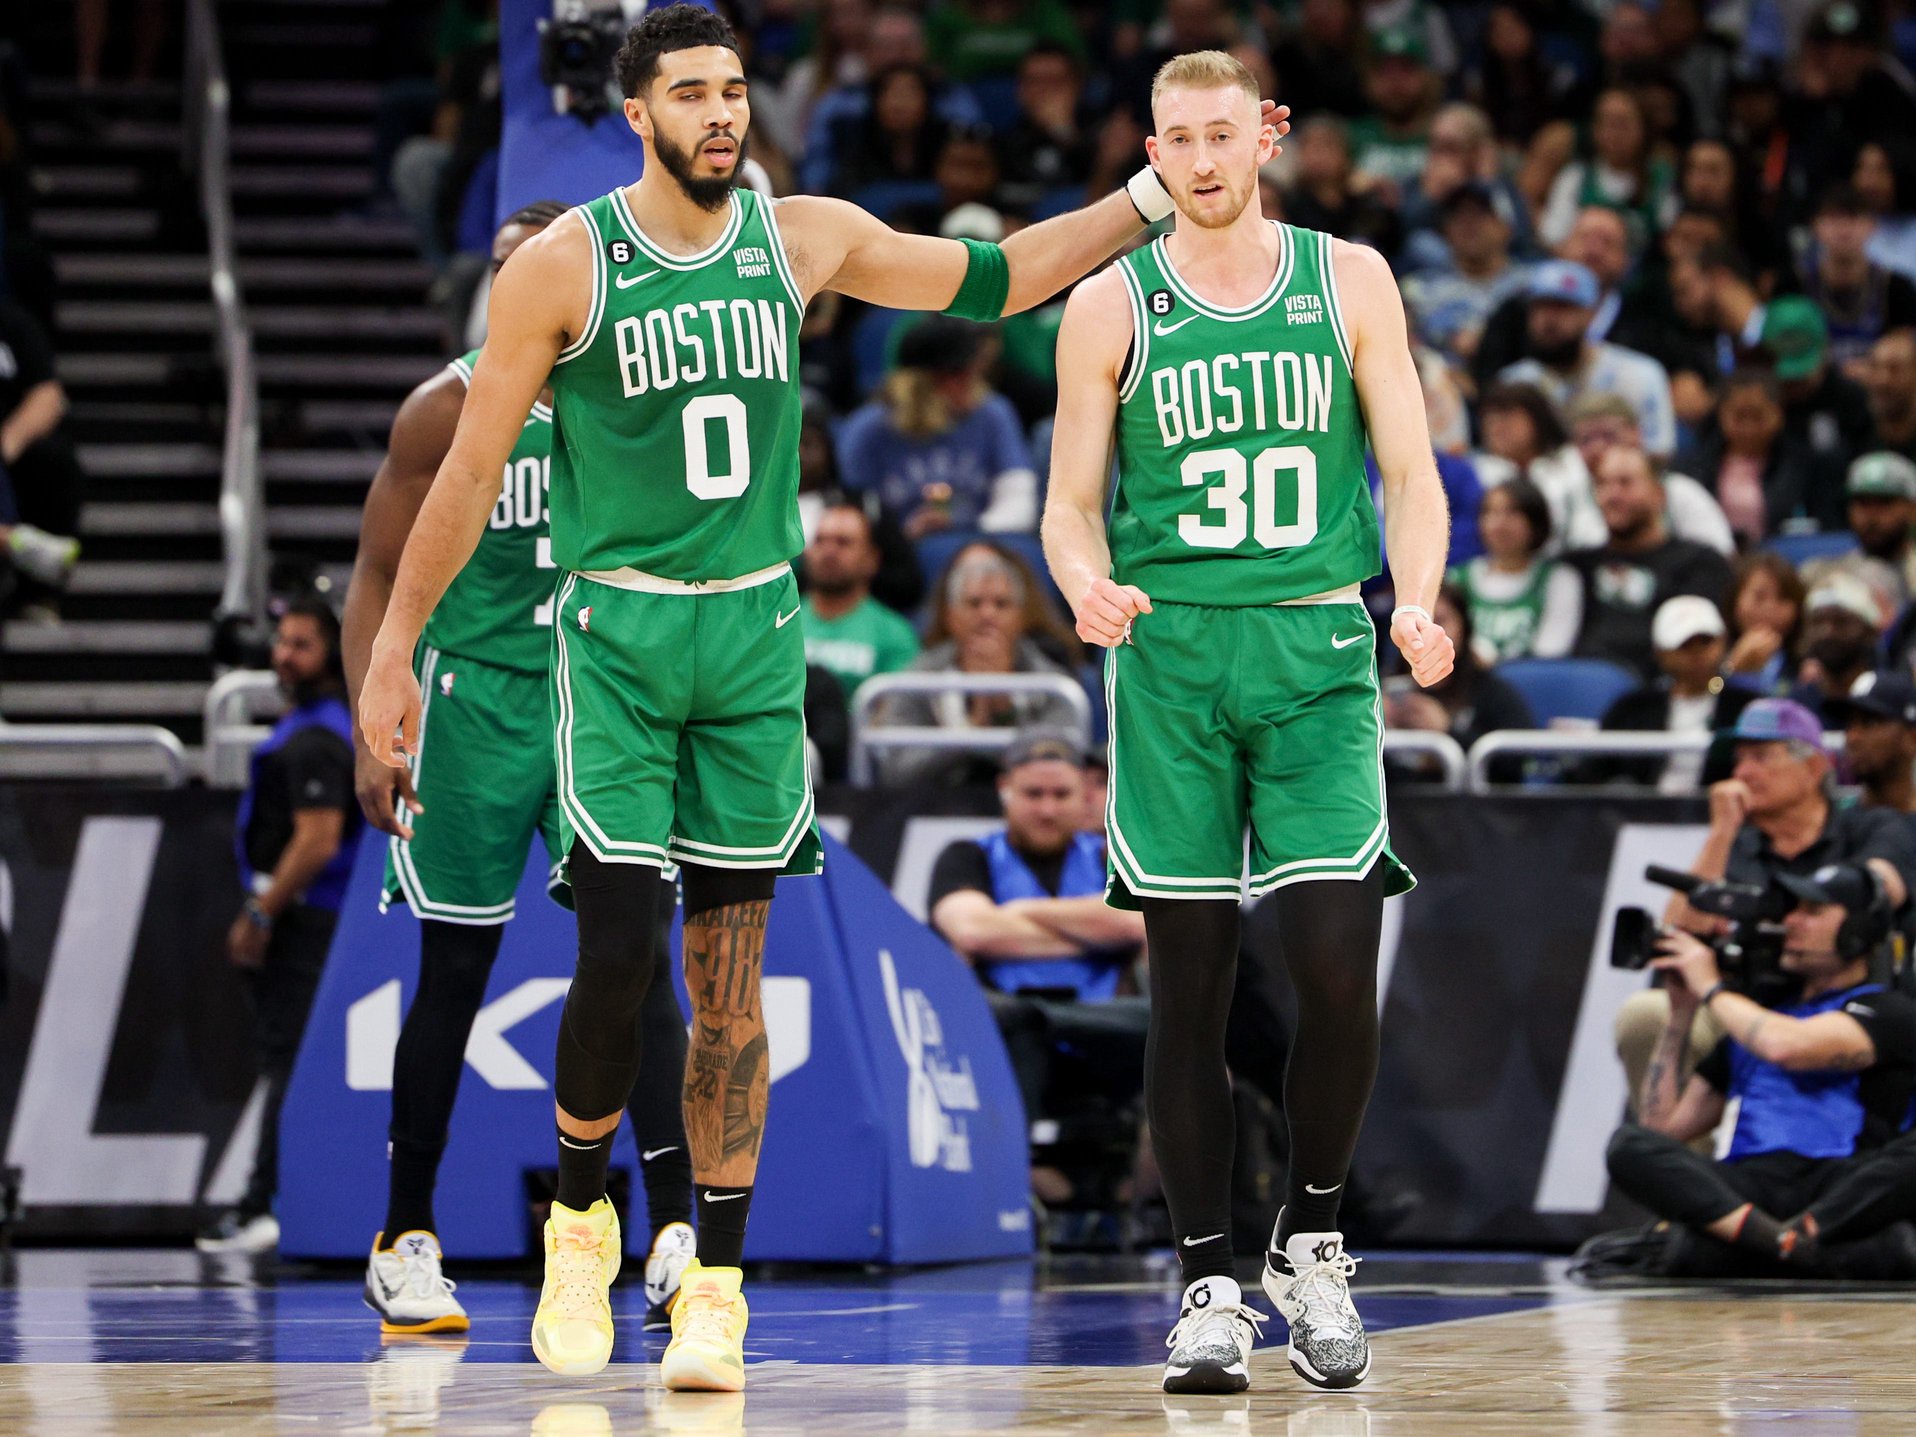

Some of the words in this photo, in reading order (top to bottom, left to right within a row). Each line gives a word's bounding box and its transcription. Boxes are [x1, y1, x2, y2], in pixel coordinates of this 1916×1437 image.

[612, 242, 629, 263] 6
[733, 247, 769, 265] VISTA
[737, 263, 771, 278] PRINT
[1153, 292, 1169, 313] 6
[1284, 294, 1322, 312] VISTA
[1286, 310, 1323, 325] PRINT
[614, 299, 788, 398] BOSTON
[1151, 351, 1332, 448] BOSTON
[681, 393, 750, 501] 0
[1178, 445, 1318, 550] 30
